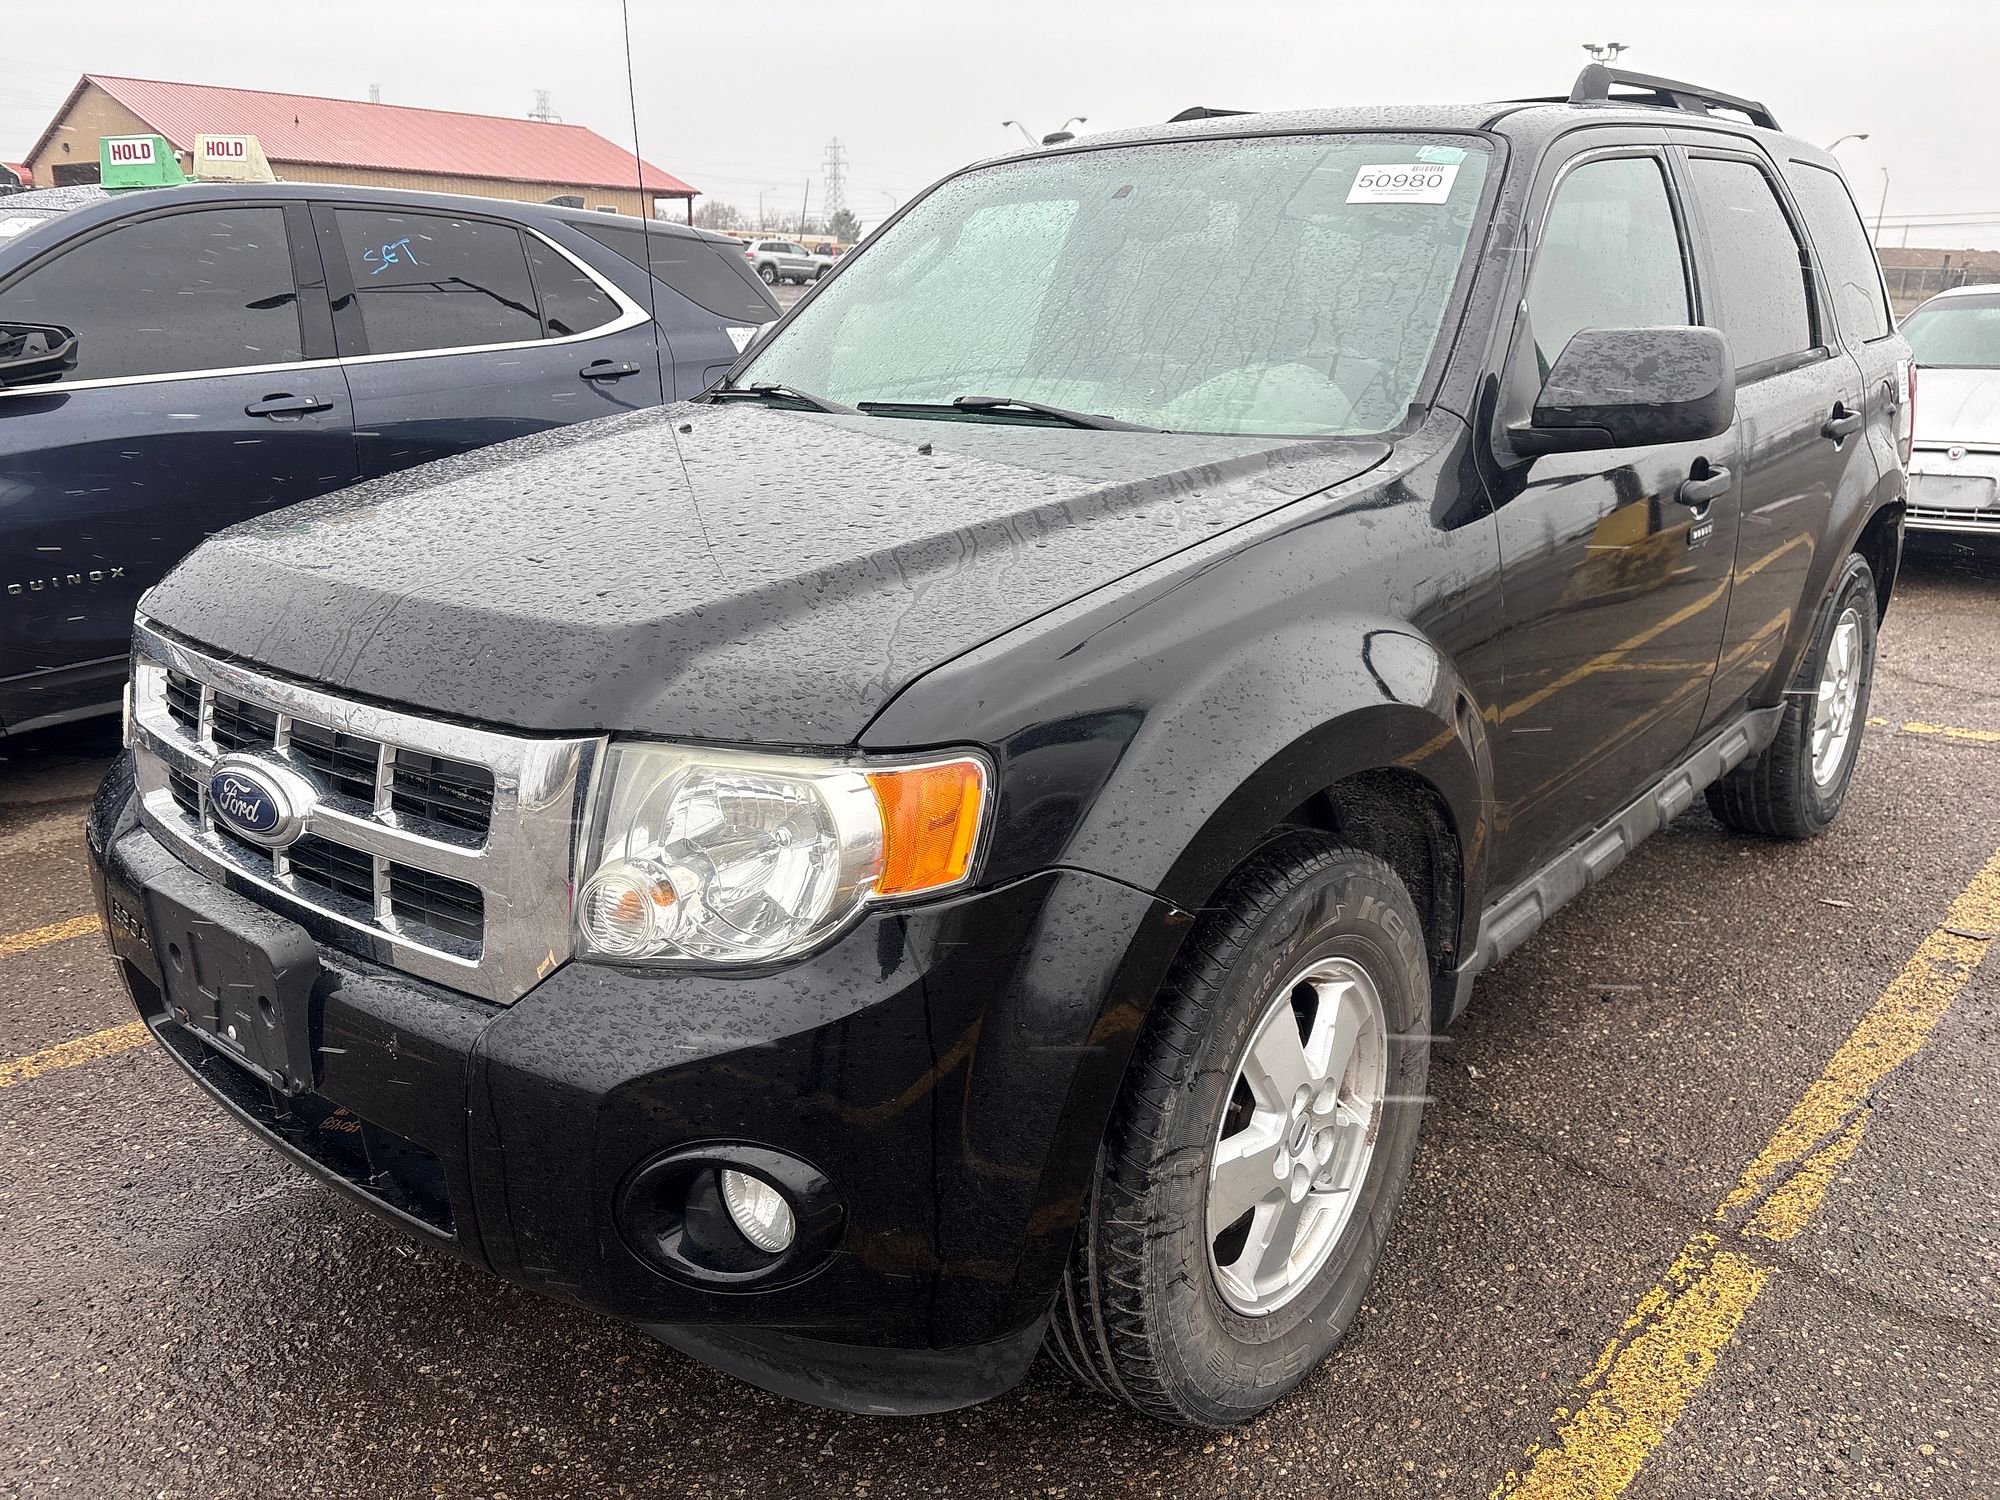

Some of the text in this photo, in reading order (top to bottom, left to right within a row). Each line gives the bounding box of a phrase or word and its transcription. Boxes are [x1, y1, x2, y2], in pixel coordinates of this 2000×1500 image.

[111, 143, 151, 161] HOLD
[206, 141, 243, 157] HOLD
[1358, 174, 1443, 188] 50980
[363, 238, 418, 275] SET
[7, 567, 125, 595] QUINOX
[220, 778, 261, 823] Ford
[112, 898, 152, 951] ESCA
